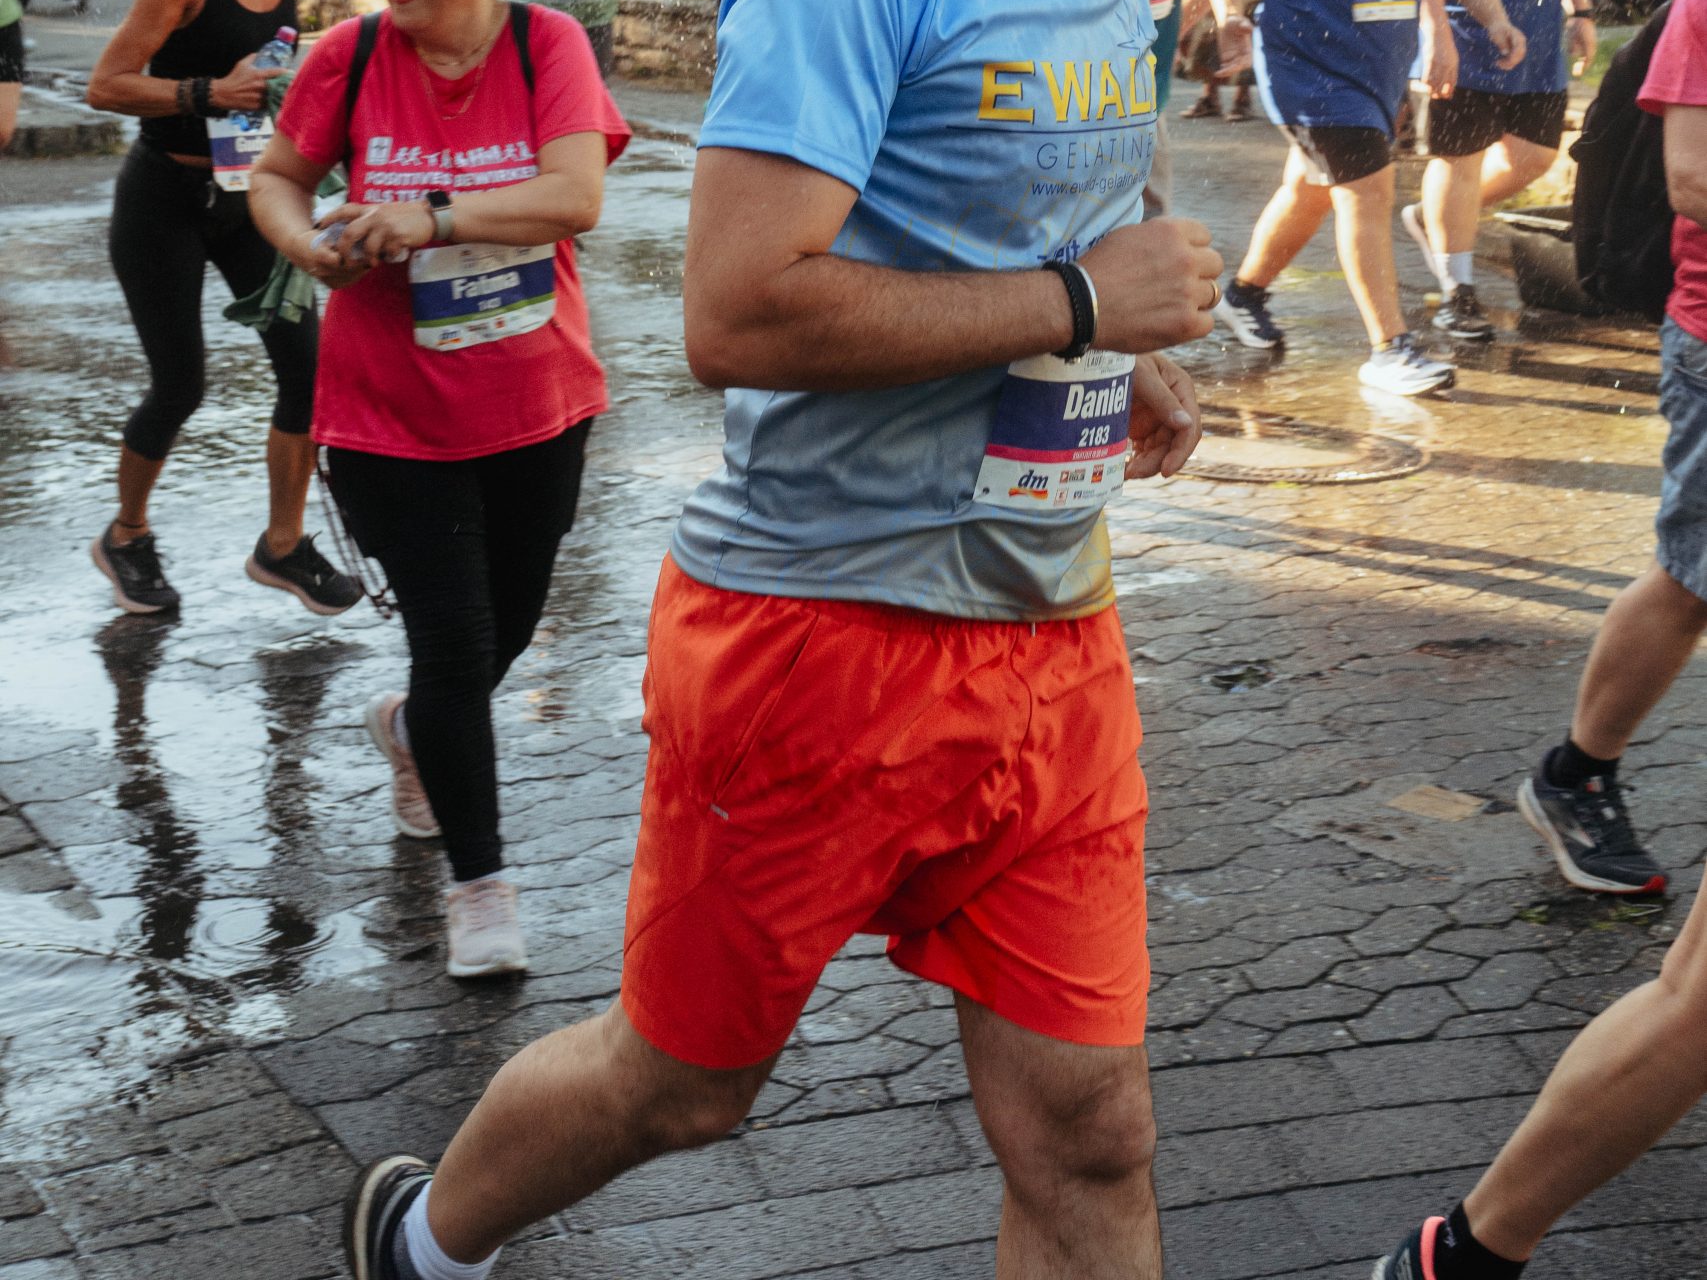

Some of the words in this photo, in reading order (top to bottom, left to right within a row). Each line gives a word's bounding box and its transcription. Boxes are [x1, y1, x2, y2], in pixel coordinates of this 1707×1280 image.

[1063, 375, 1130, 420] Daniel
[1078, 425, 1111, 448] 2183
[1018, 469, 1048, 489] dm
